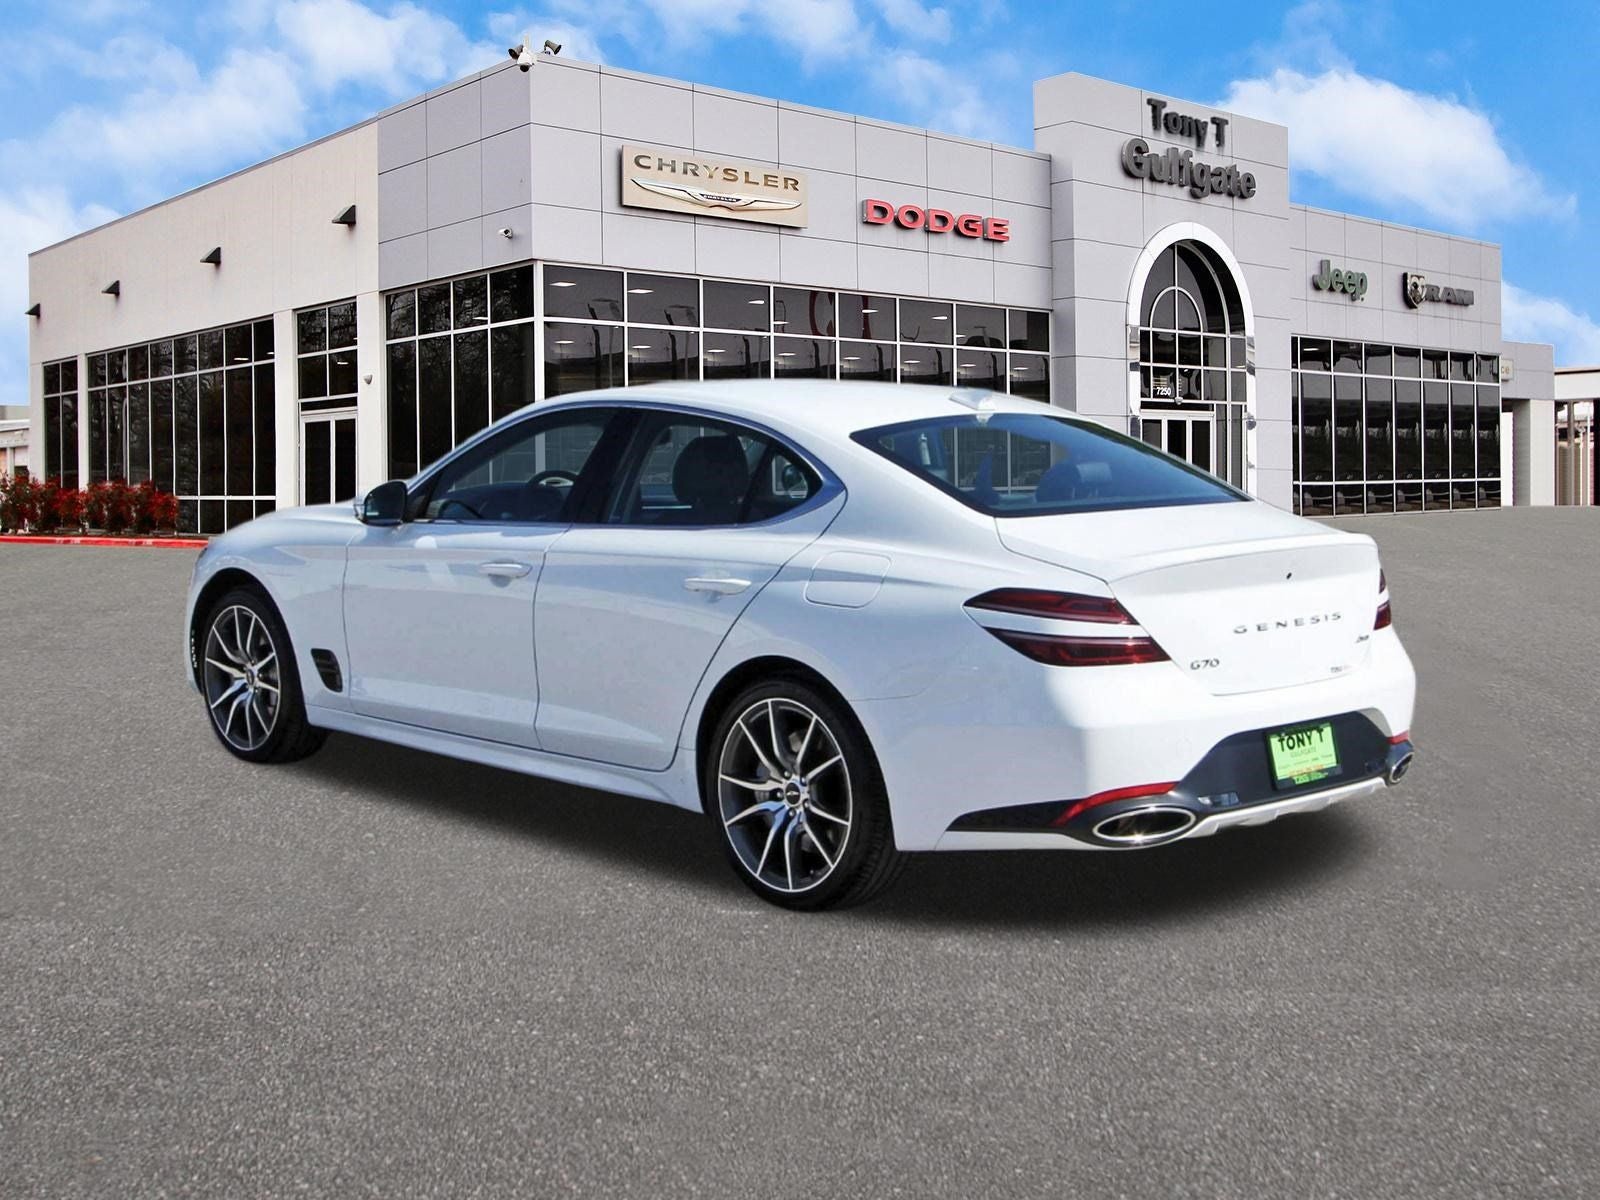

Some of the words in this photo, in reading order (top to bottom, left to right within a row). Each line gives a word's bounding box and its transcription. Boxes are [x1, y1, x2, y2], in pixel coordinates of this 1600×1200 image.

[1147, 98, 1208, 147] Tony
[1210, 116, 1229, 147] T
[634, 154, 800, 192] CHRYSLER
[1121, 138, 1257, 199] Gulfgate
[862, 199, 1010, 243] DODGE
[1312, 259, 1368, 302] Jeep
[1424, 283, 1475, 307] RAM
[1156, 386, 1172, 396] 7250
[1233, 611, 1342, 635] GENESIS
[1190, 658, 1220, 671] G70
[1278, 728, 1313, 752] TONY
[1315, 726, 1325, 742] T
